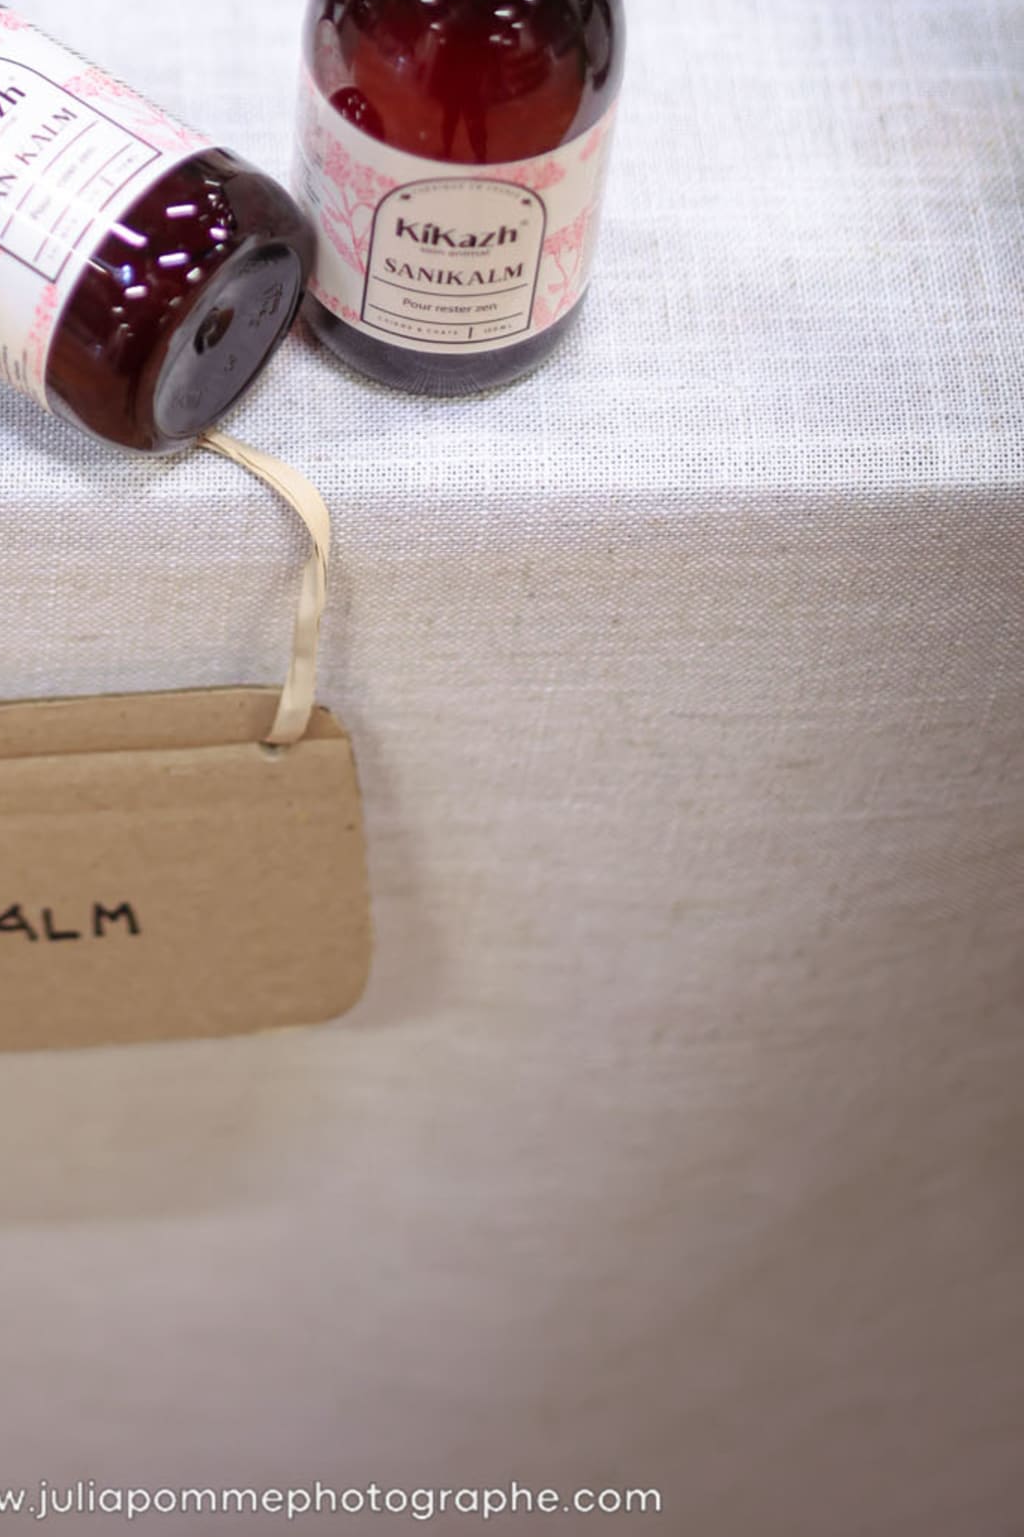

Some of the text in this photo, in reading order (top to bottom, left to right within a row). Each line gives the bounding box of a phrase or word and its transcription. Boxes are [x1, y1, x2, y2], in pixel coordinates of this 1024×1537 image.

[383, 257, 524, 287] SANIKALM
[402, 296, 498, 313] Pour rester zen
